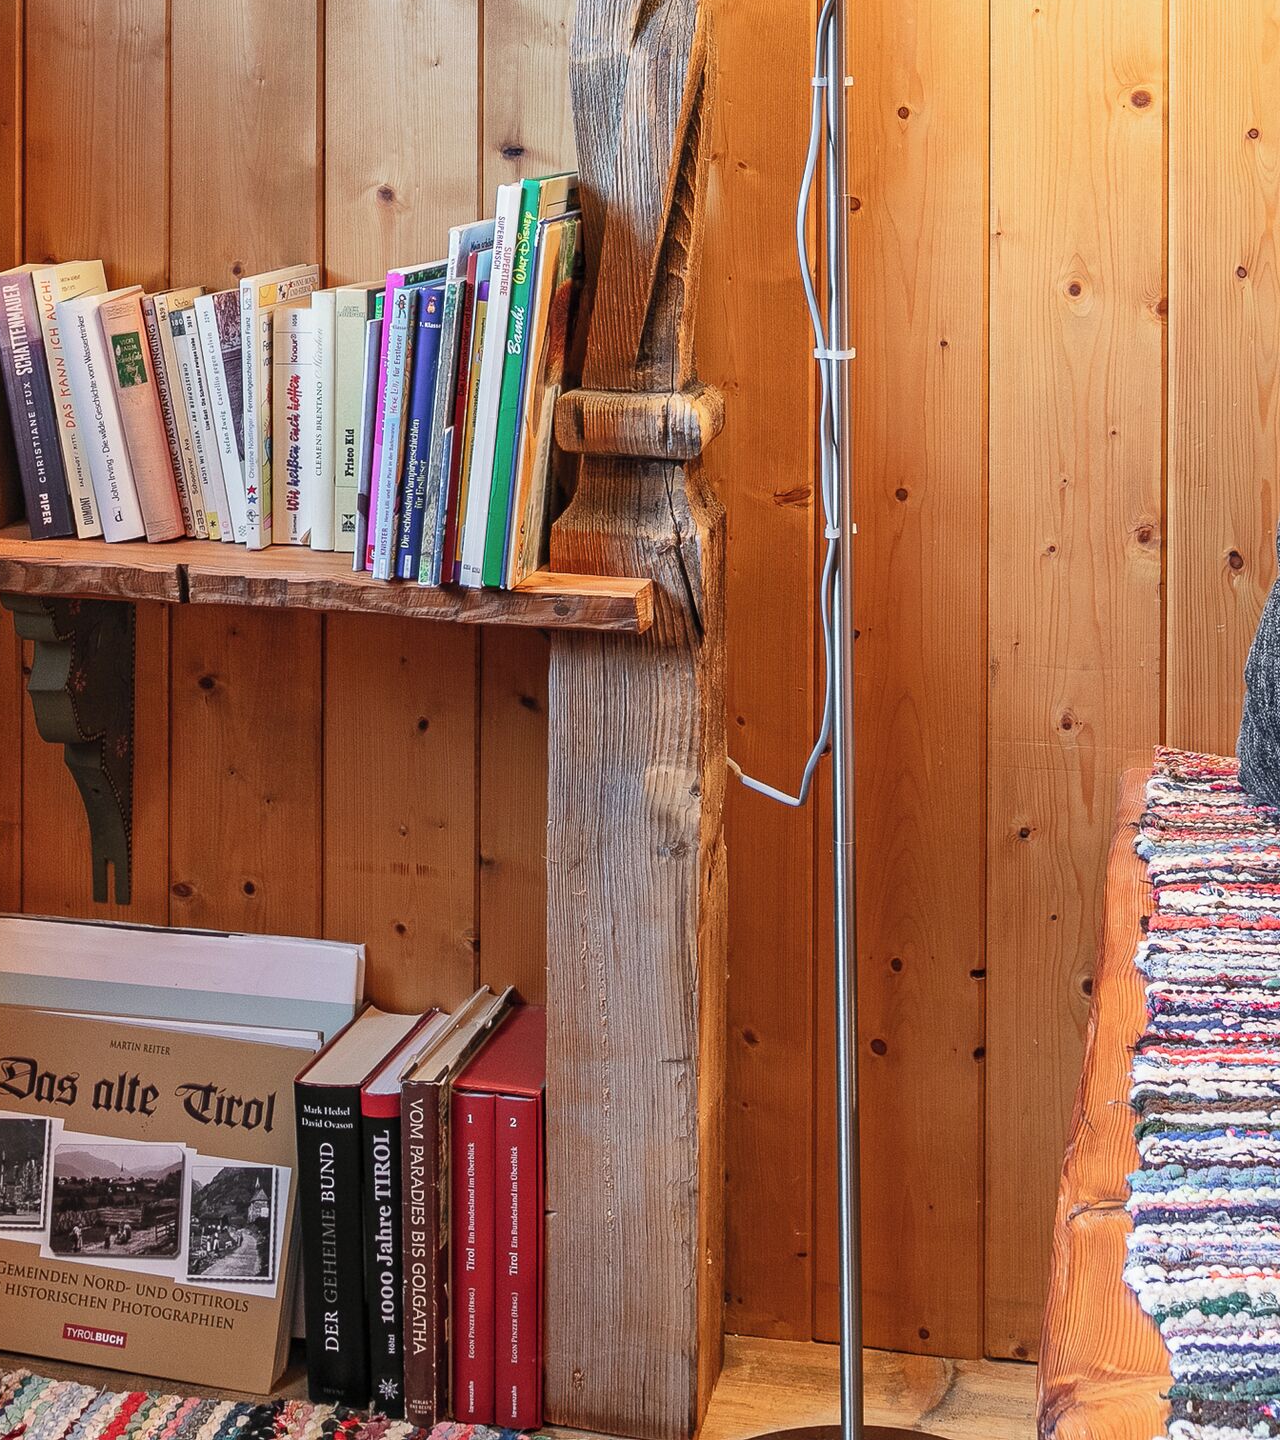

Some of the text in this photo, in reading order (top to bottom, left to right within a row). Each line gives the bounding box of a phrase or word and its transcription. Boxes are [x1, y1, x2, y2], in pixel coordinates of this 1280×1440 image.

[493, 215, 506, 270] SUPERMENSCH
[40, 279, 77, 430] DAS KANN ICH AUCH!
[507, 305, 526, 356] Bambi
[1, 283, 48, 484] CHRISTIANE FUX SCHATTENMAUER
[345, 428, 355, 478] Frisco Kid
[110, 1039, 171, 1056] MARTIN REITER
[92, 1070, 160, 1118] alte
[174, 1082, 278, 1133] Tirol
[301, 1116, 354, 1130] David Ovason
[303, 1104, 351, 1117] Mark Hedsel
[319, 1141, 341, 1354] DER GEHEIME BUND
[371, 1128, 397, 1324] 1000 Jahre TIROL
[408, 1098, 428, 1356] VOM PARADIES BIS GOLGATHA
